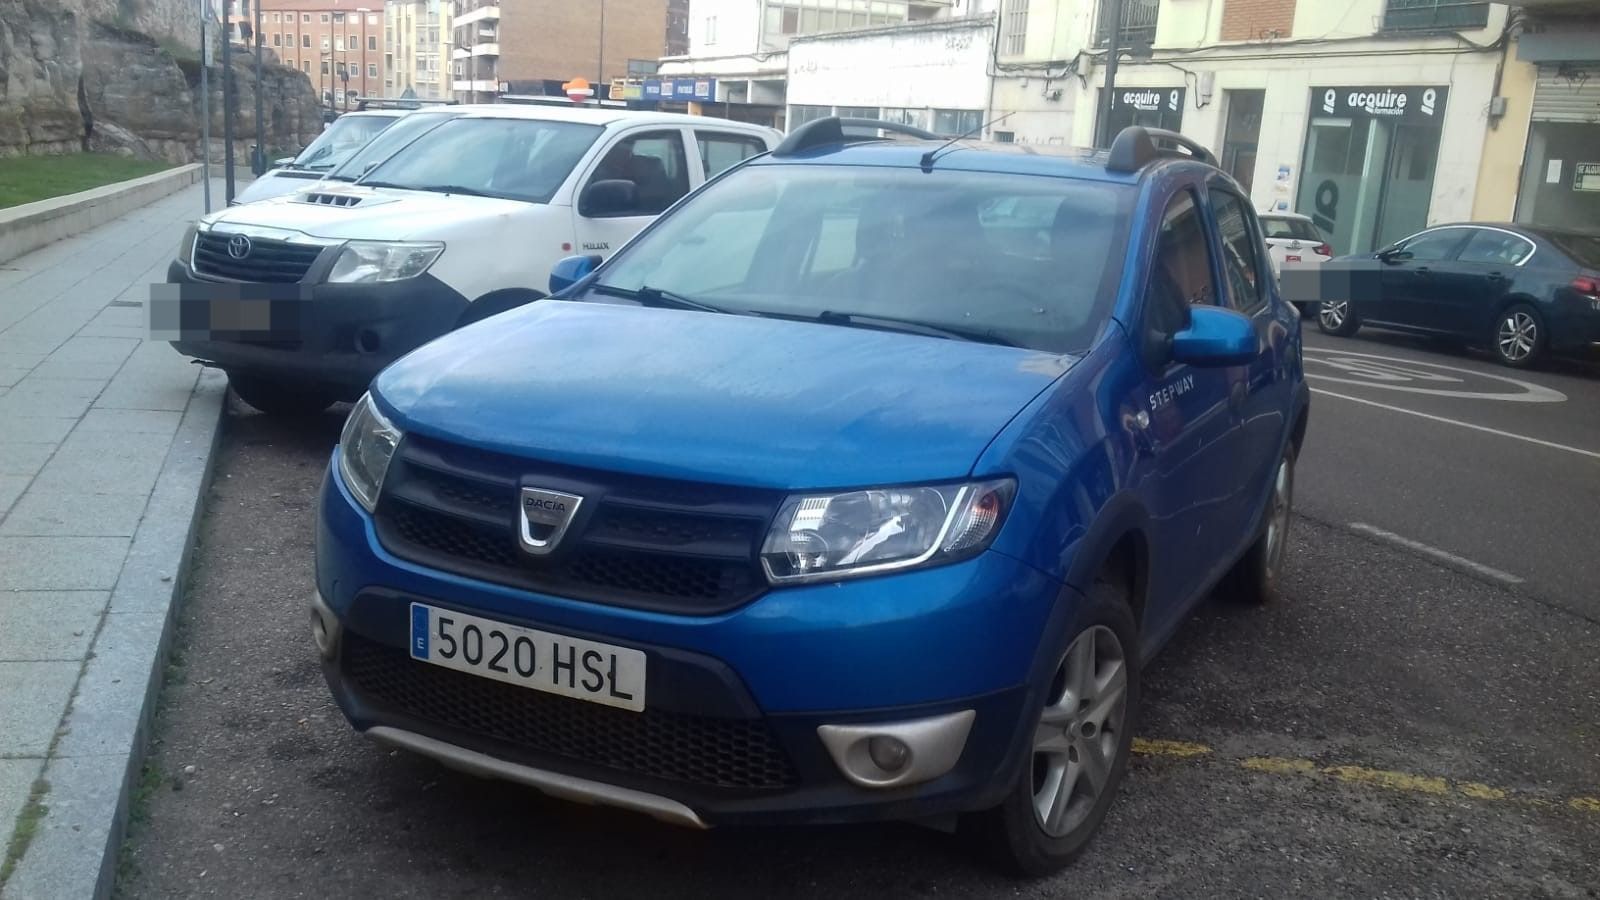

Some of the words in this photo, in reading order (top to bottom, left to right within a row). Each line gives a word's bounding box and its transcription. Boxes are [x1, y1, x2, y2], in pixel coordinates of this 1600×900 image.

[1123, 90, 1161, 109] acquire
[1347, 89, 1407, 112] acquire
[582, 242, 610, 250] HILUX
[1149, 374, 1195, 411] STEPWAY
[525, 497, 566, 513] DACIA
[416, 637, 425, 650] E
[437, 616, 537, 679] 5020
[552, 642, 634, 701] HSL
